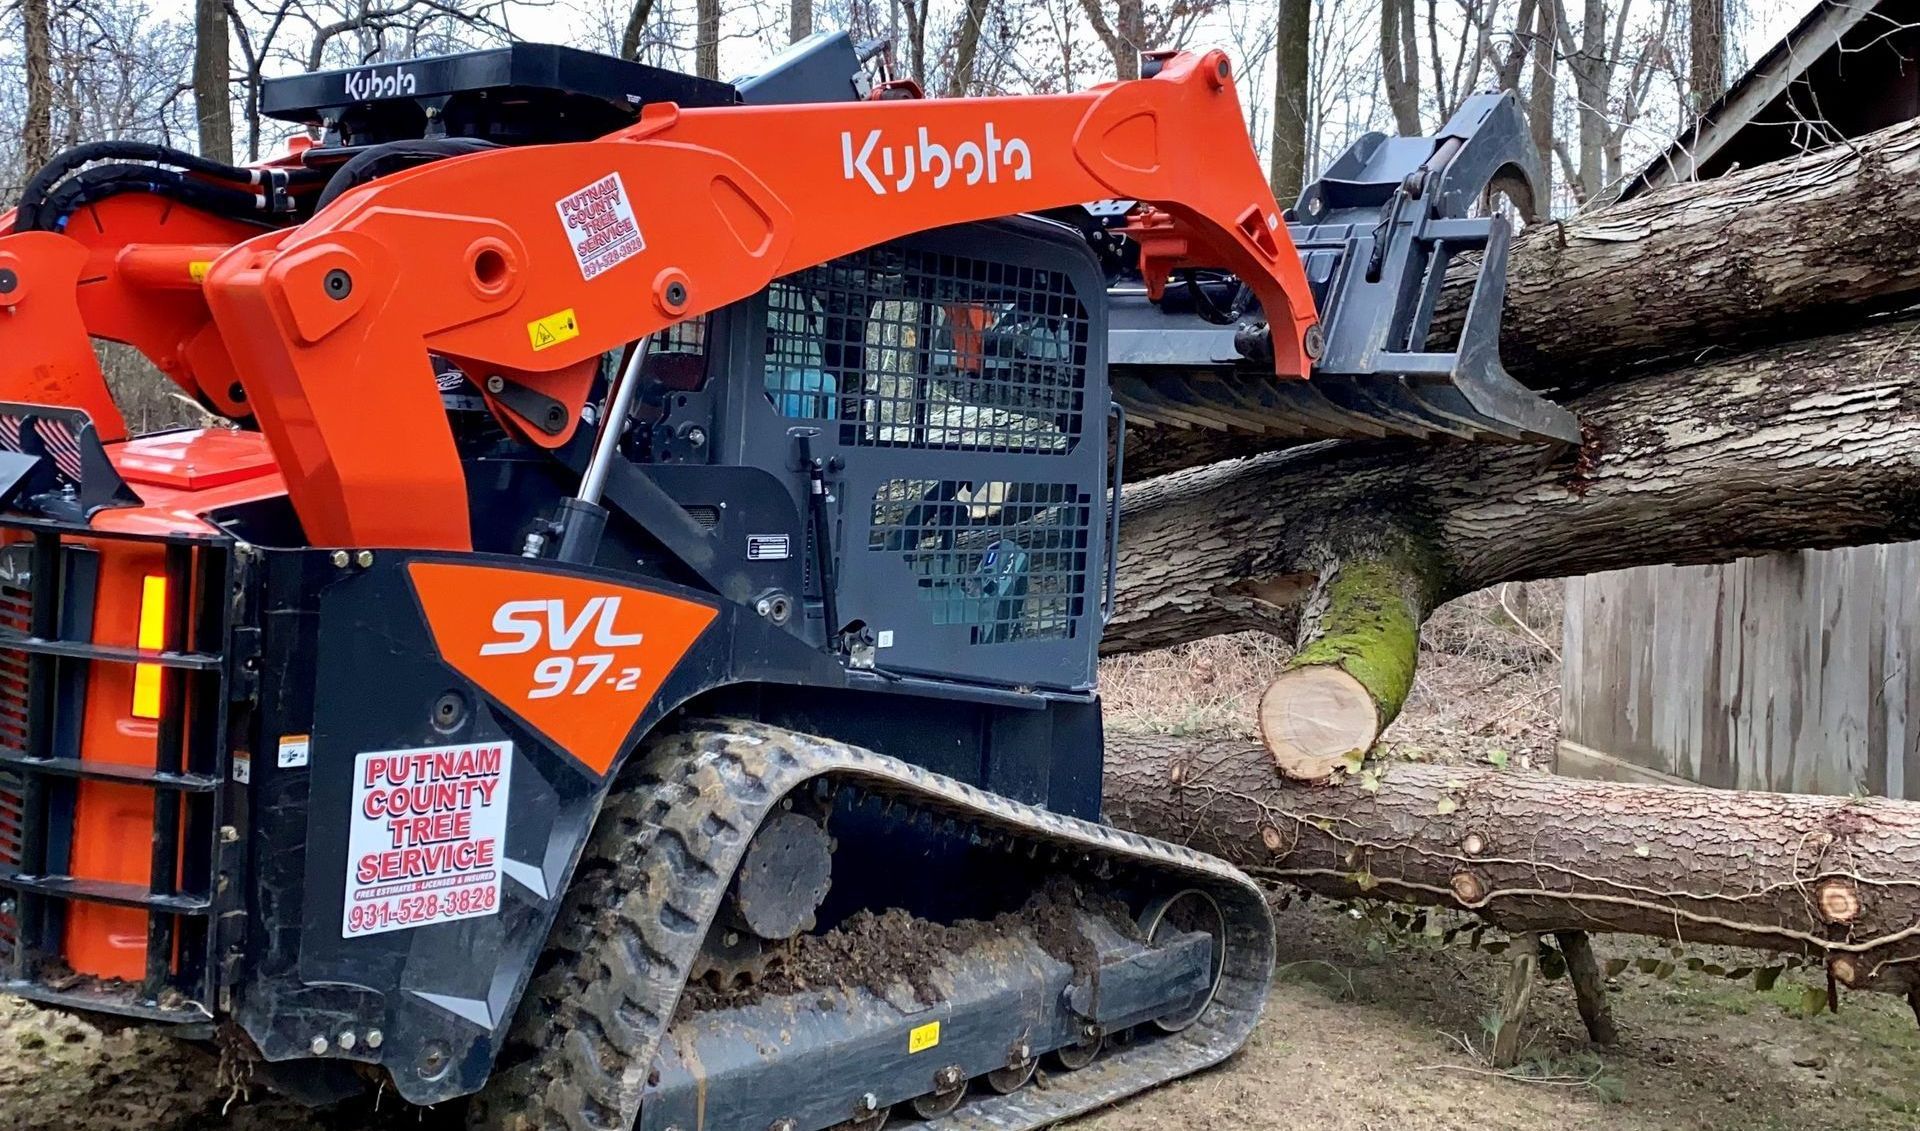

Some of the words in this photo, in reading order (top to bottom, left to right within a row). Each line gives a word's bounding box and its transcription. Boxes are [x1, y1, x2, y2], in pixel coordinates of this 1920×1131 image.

[345, 66, 415, 100] Kubota
[841, 122, 1032, 194] Kubota
[560, 176, 618, 216] PUTNAM
[567, 190, 621, 229] COUNTY
[577, 217, 634, 257] SERVICE
[581, 209, 618, 237] TREE
[479, 596, 643, 656] SVL
[527, 654, 641, 699] 97-2
[364, 746, 502, 788] PUTNAM
[363, 778, 499, 820] COUNTY
[388, 811, 472, 848] TREE
[357, 838, 495, 884] SERVICE
[356, 887, 377, 900] FREE
[376, 882, 415, 897] ESTIMATES
[421, 876, 455, 890] LICENSED
[463, 871, 494, 884] INSURED
[349, 886, 496, 932] 931-528-3828
